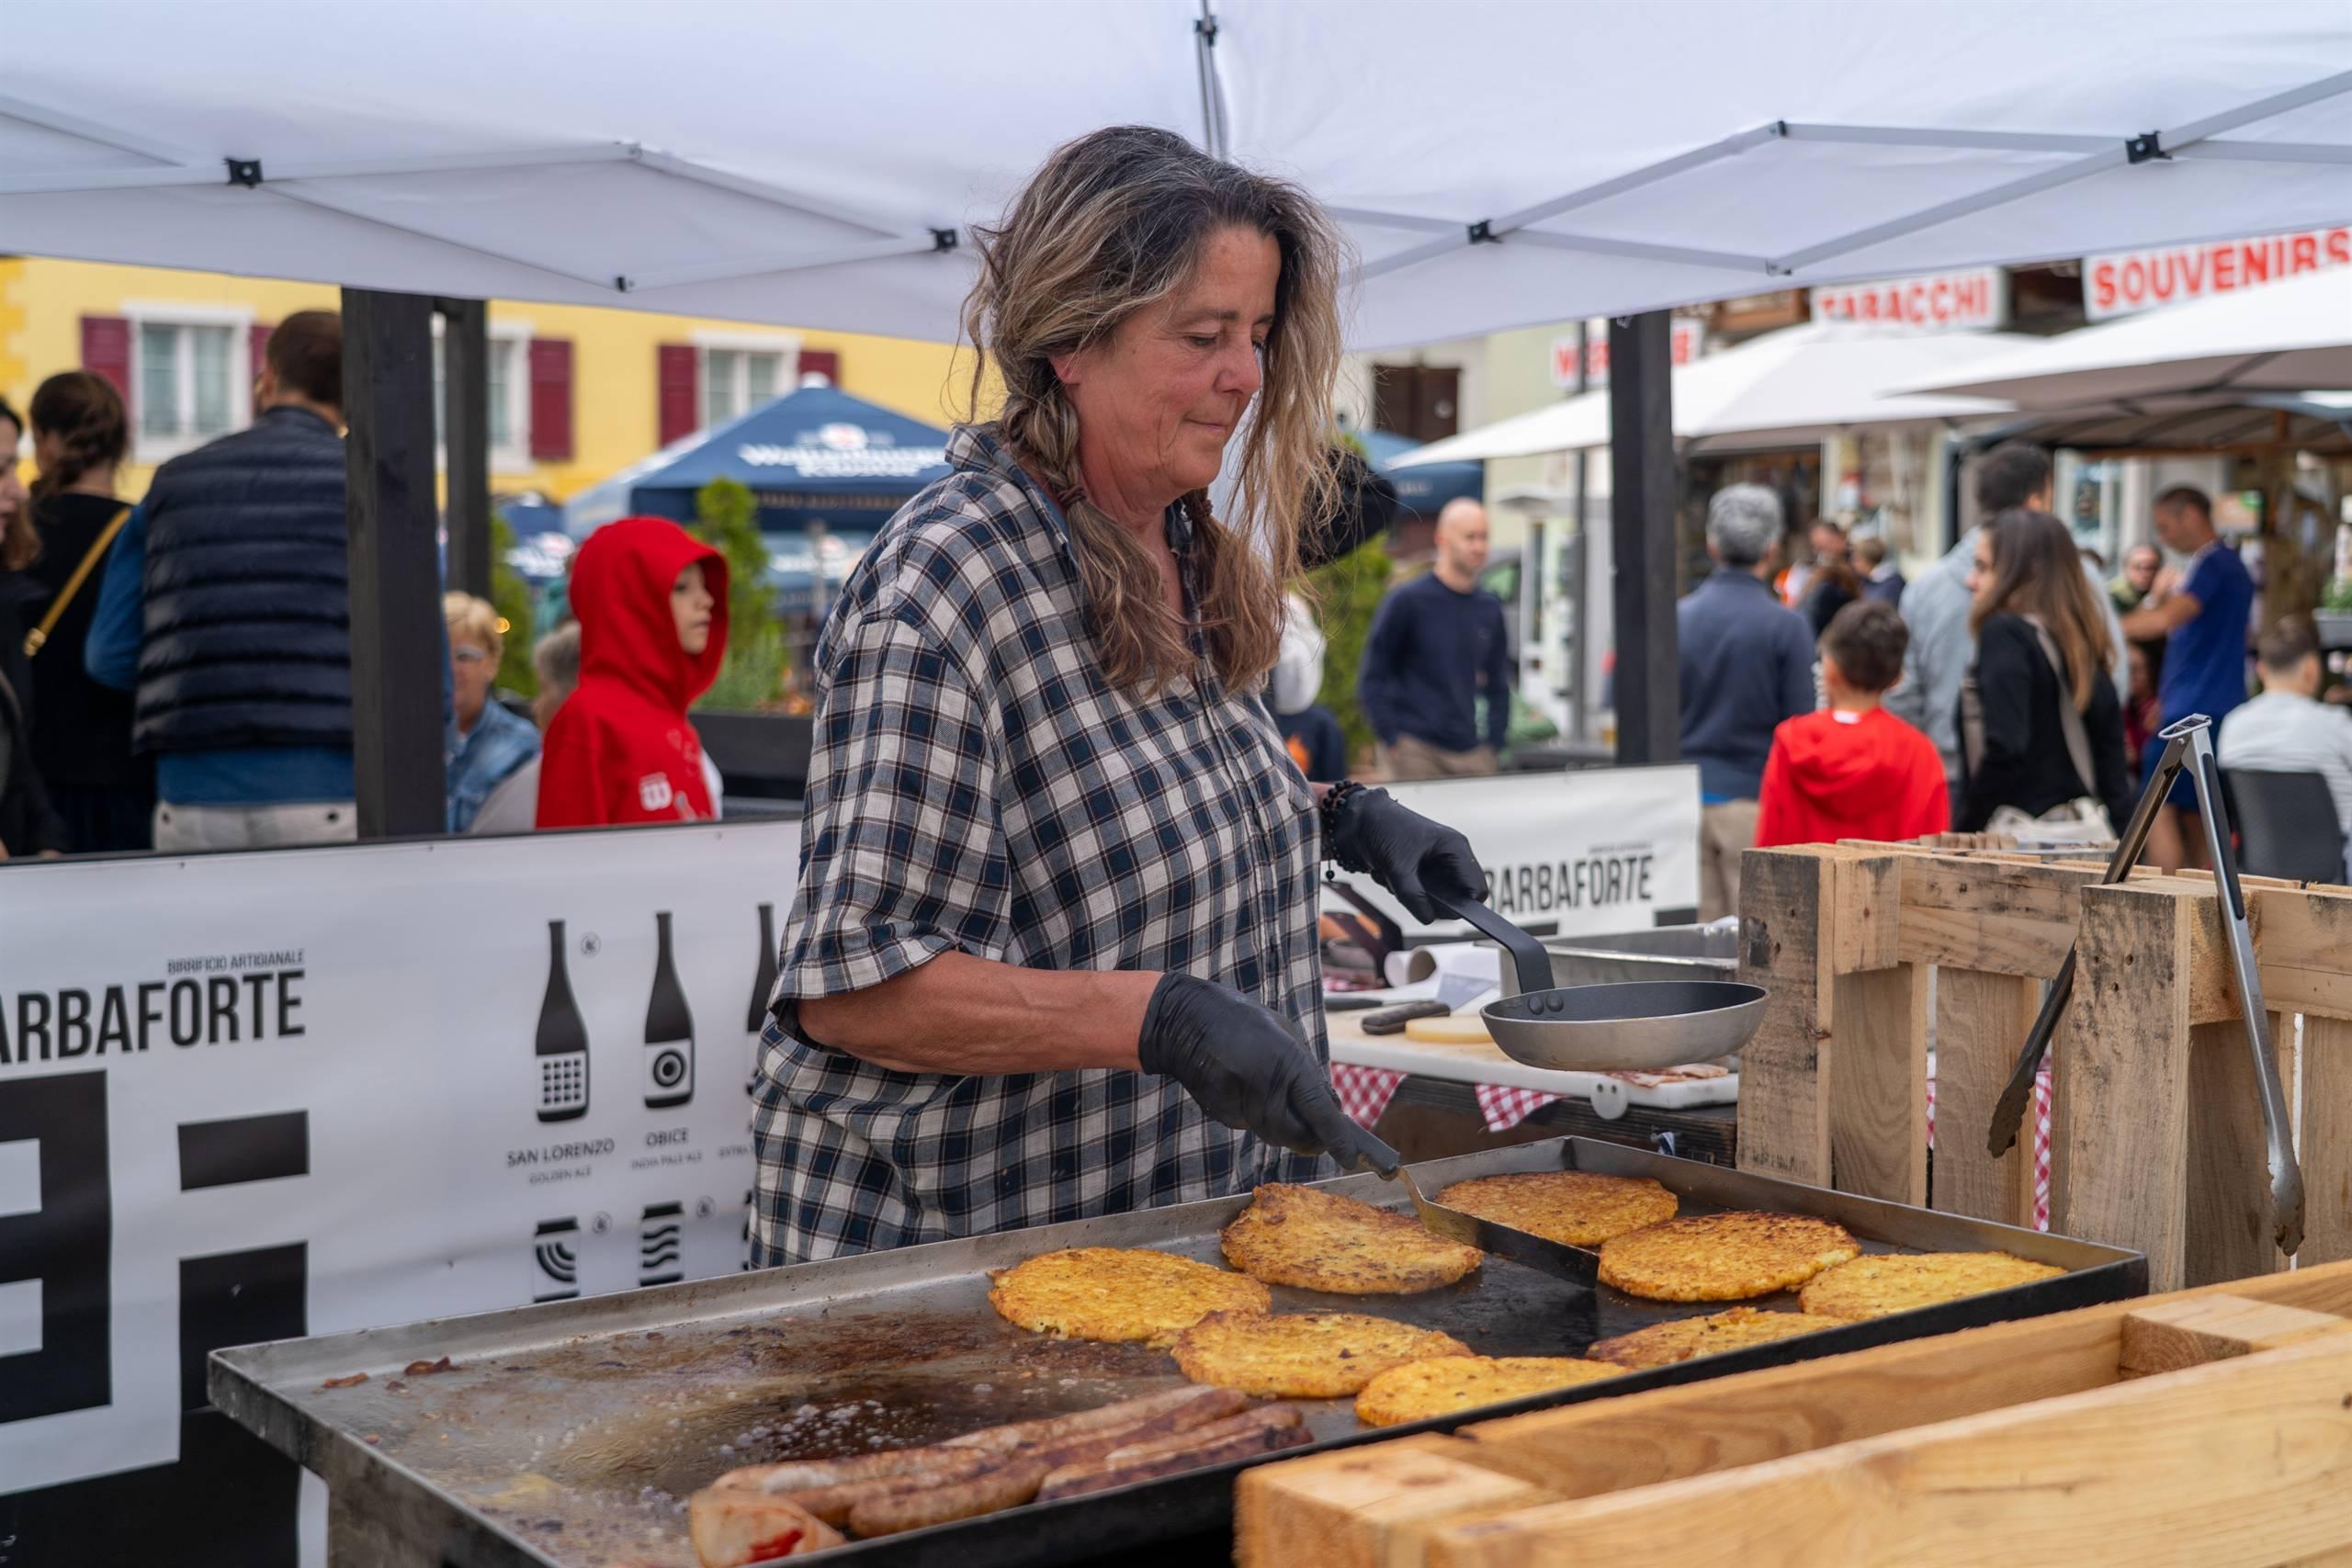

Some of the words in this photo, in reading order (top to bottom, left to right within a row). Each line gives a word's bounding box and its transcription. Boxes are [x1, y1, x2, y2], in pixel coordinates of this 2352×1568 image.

[2093, 227, 2351, 308] SOUVENIRS
[168, 955, 228, 975] BIRRIFICIO
[231, 948, 305, 969] ARTIGIANALE
[645, 1128, 689, 1147] OBICE
[507, 1149, 539, 1168] SAN
[543, 1138, 616, 1164] LORENZO
